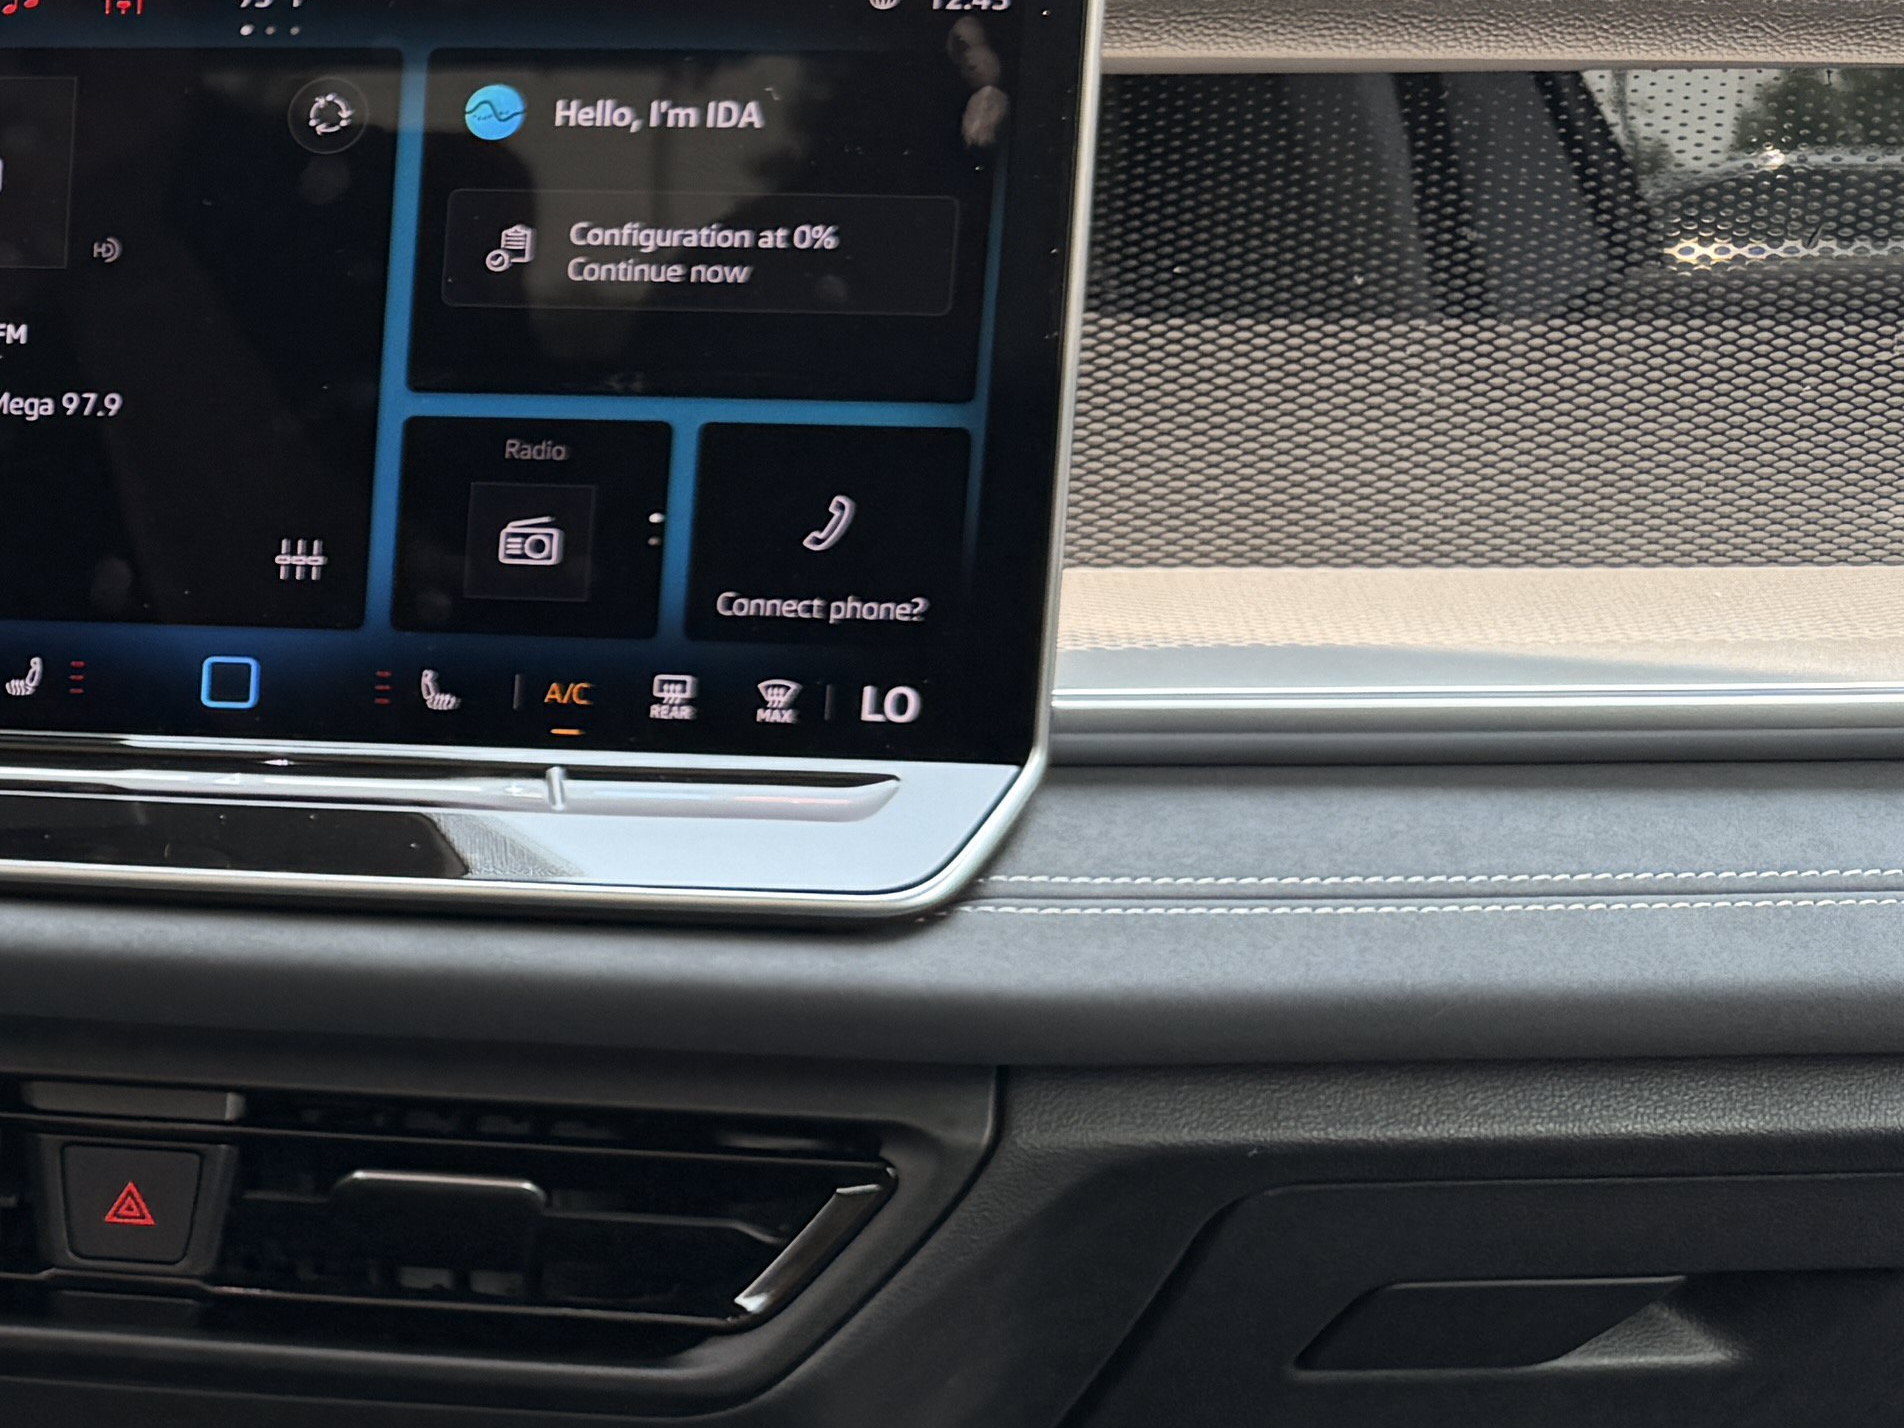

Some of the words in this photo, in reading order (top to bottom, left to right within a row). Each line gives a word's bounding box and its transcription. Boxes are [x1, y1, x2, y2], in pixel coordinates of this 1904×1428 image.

[554, 99, 642, 133] Hello,
[649, 100, 699, 128] I'm
[706, 100, 763, 129] IDA
[569, 221, 752, 253] Configuration
[757, 227, 789, 249] at
[793, 224, 838, 250] 0%
[567, 256, 685, 283] Continue
[690, 264, 750, 284] now
[61, 392, 123, 417] 97.9
[504, 438, 567, 461] Radio
[716, 591, 824, 619] Connect
[828, 595, 927, 624] phone?
[544, 682, 590, 705] A/C
[860, 685, 920, 723] LO
[649, 705, 693, 719] REAR
[756, 709, 793, 724] MAX
